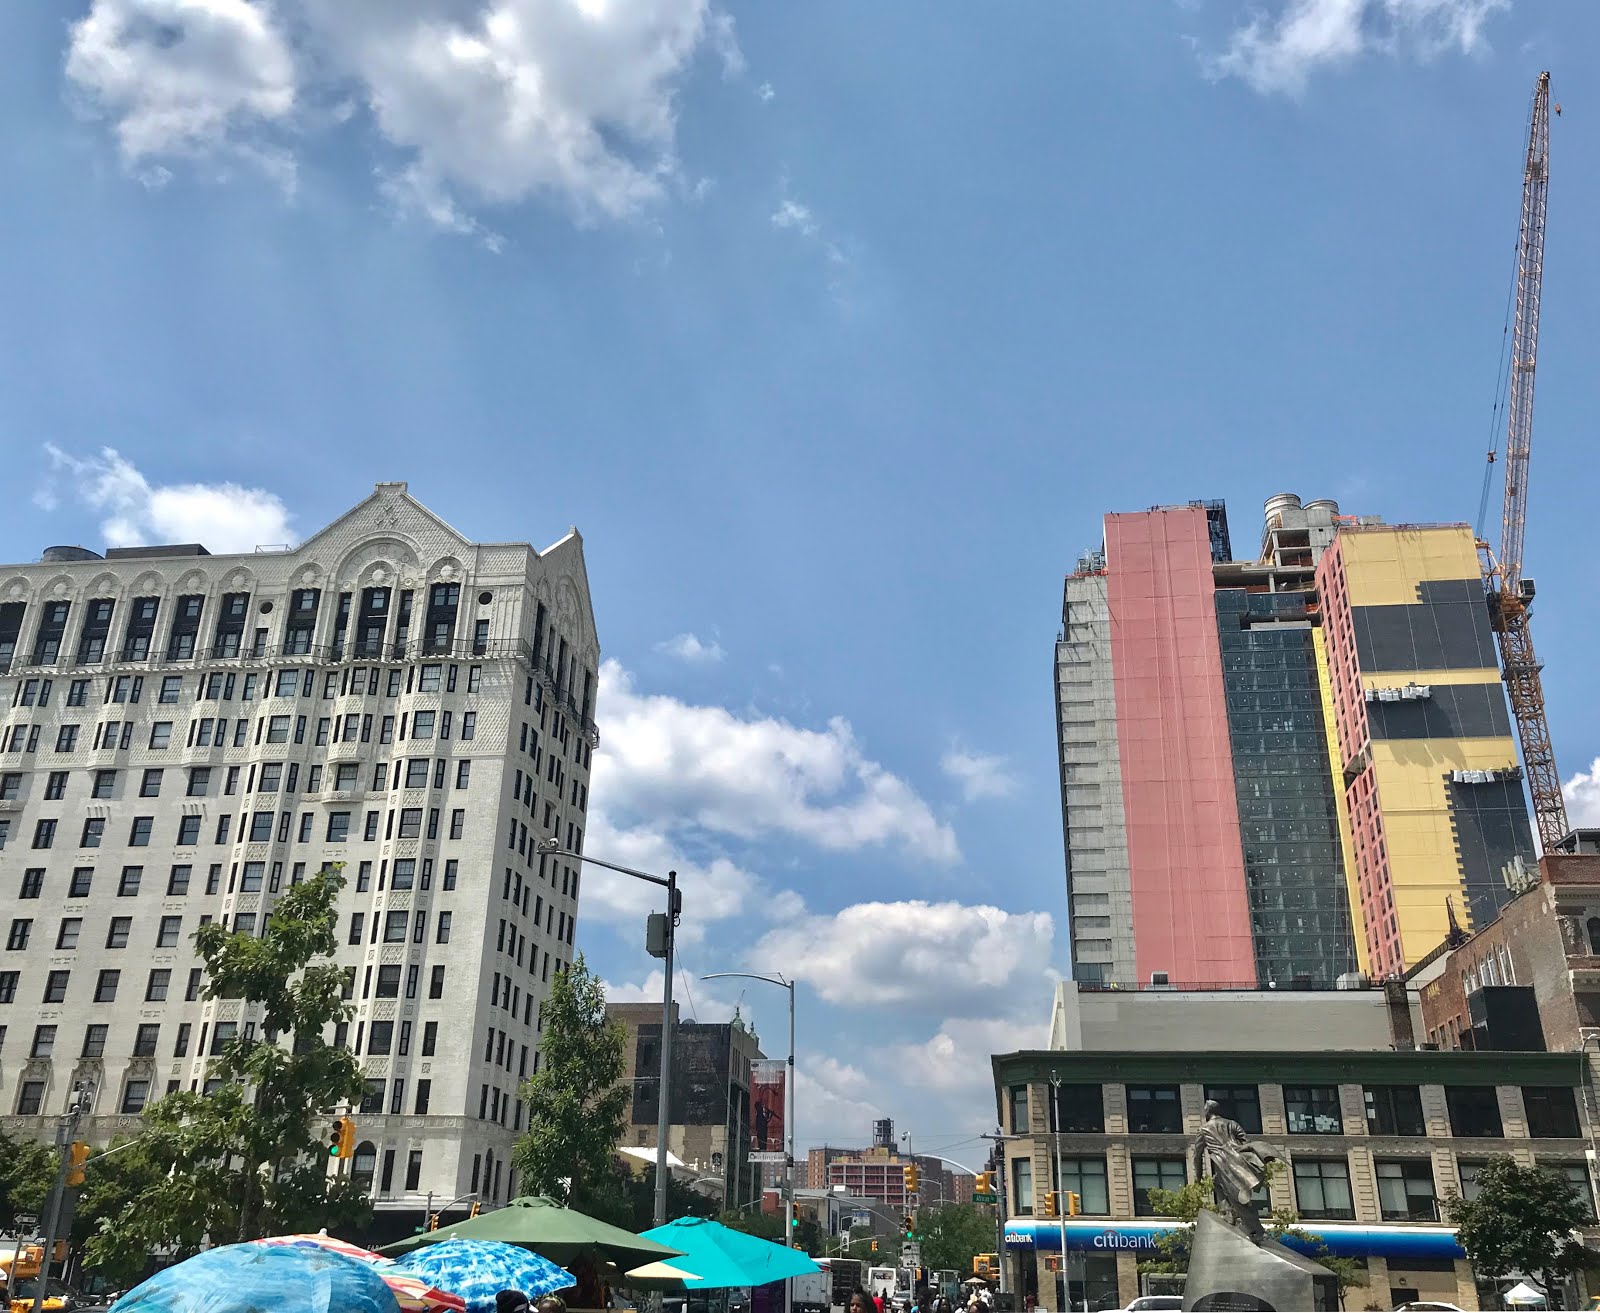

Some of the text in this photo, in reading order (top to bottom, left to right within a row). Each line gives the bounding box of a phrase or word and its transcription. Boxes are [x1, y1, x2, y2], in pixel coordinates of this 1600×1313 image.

[1005, 1232, 1032, 1242] citibank
[1094, 1231, 1156, 1248] citibank
[872, 1272, 892, 1280] FedEx
